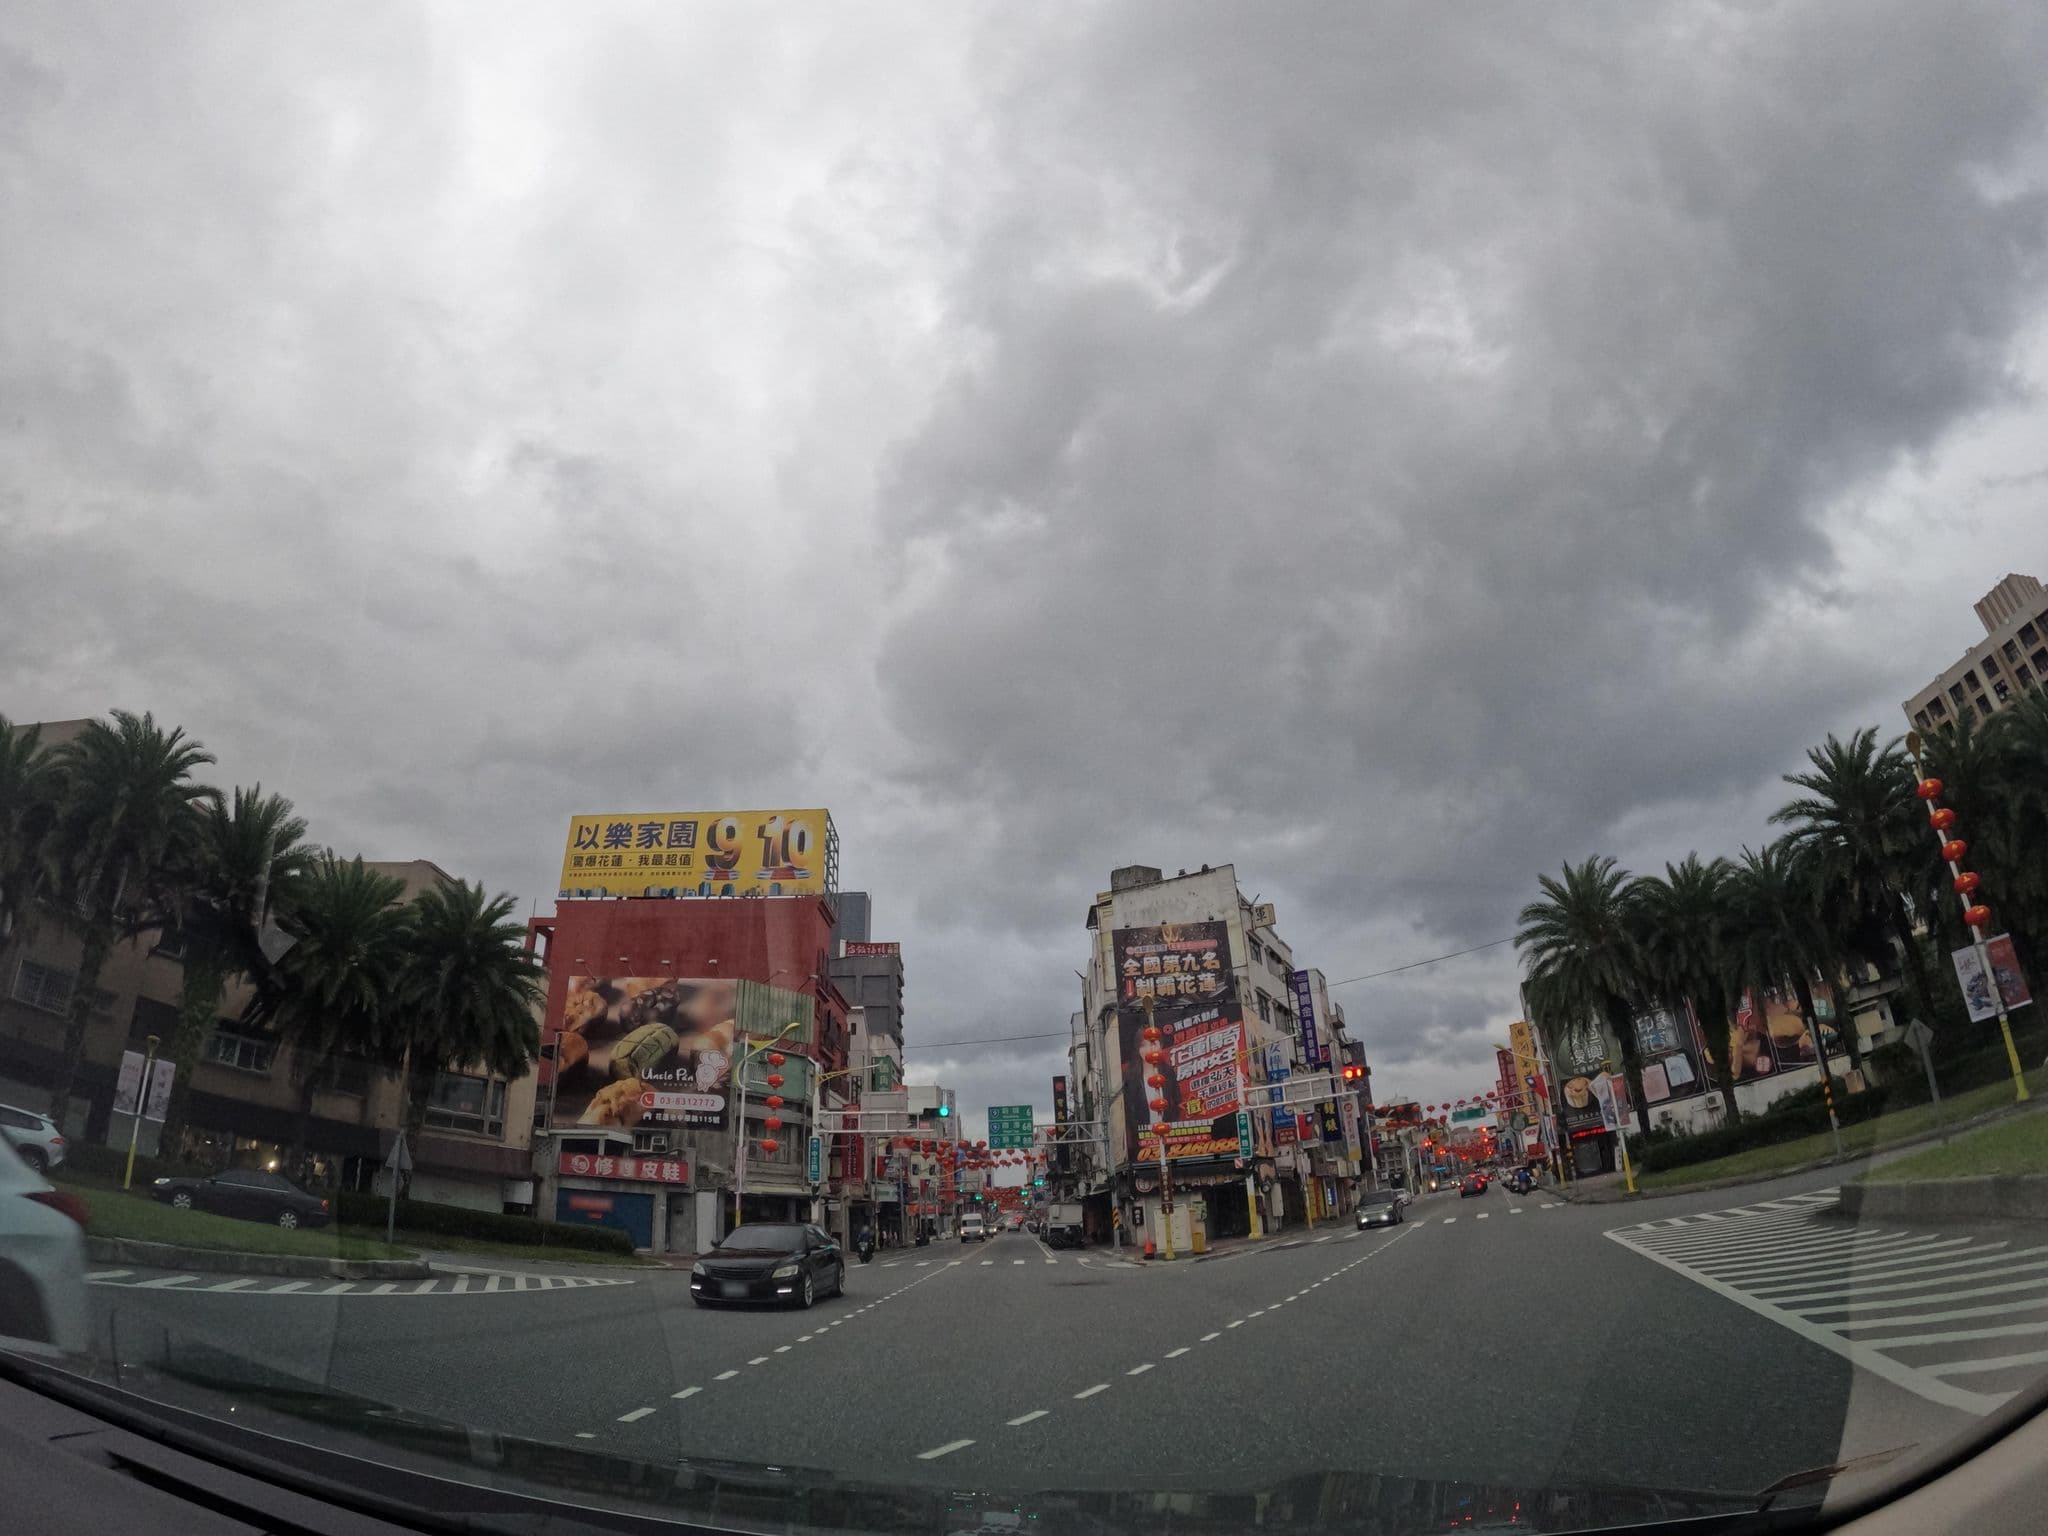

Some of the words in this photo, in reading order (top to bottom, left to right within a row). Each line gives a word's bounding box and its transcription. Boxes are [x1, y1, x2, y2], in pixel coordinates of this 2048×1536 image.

[573, 821, 698, 850] 以樂家園
[1123, 951, 1220, 977] 全國第九名
[1135, 972, 1217, 998] 制霸花蓮
[1169, 1024, 1239, 1067] 花蓮傳奇
[641, 1067, 674, 1080] Uncle
